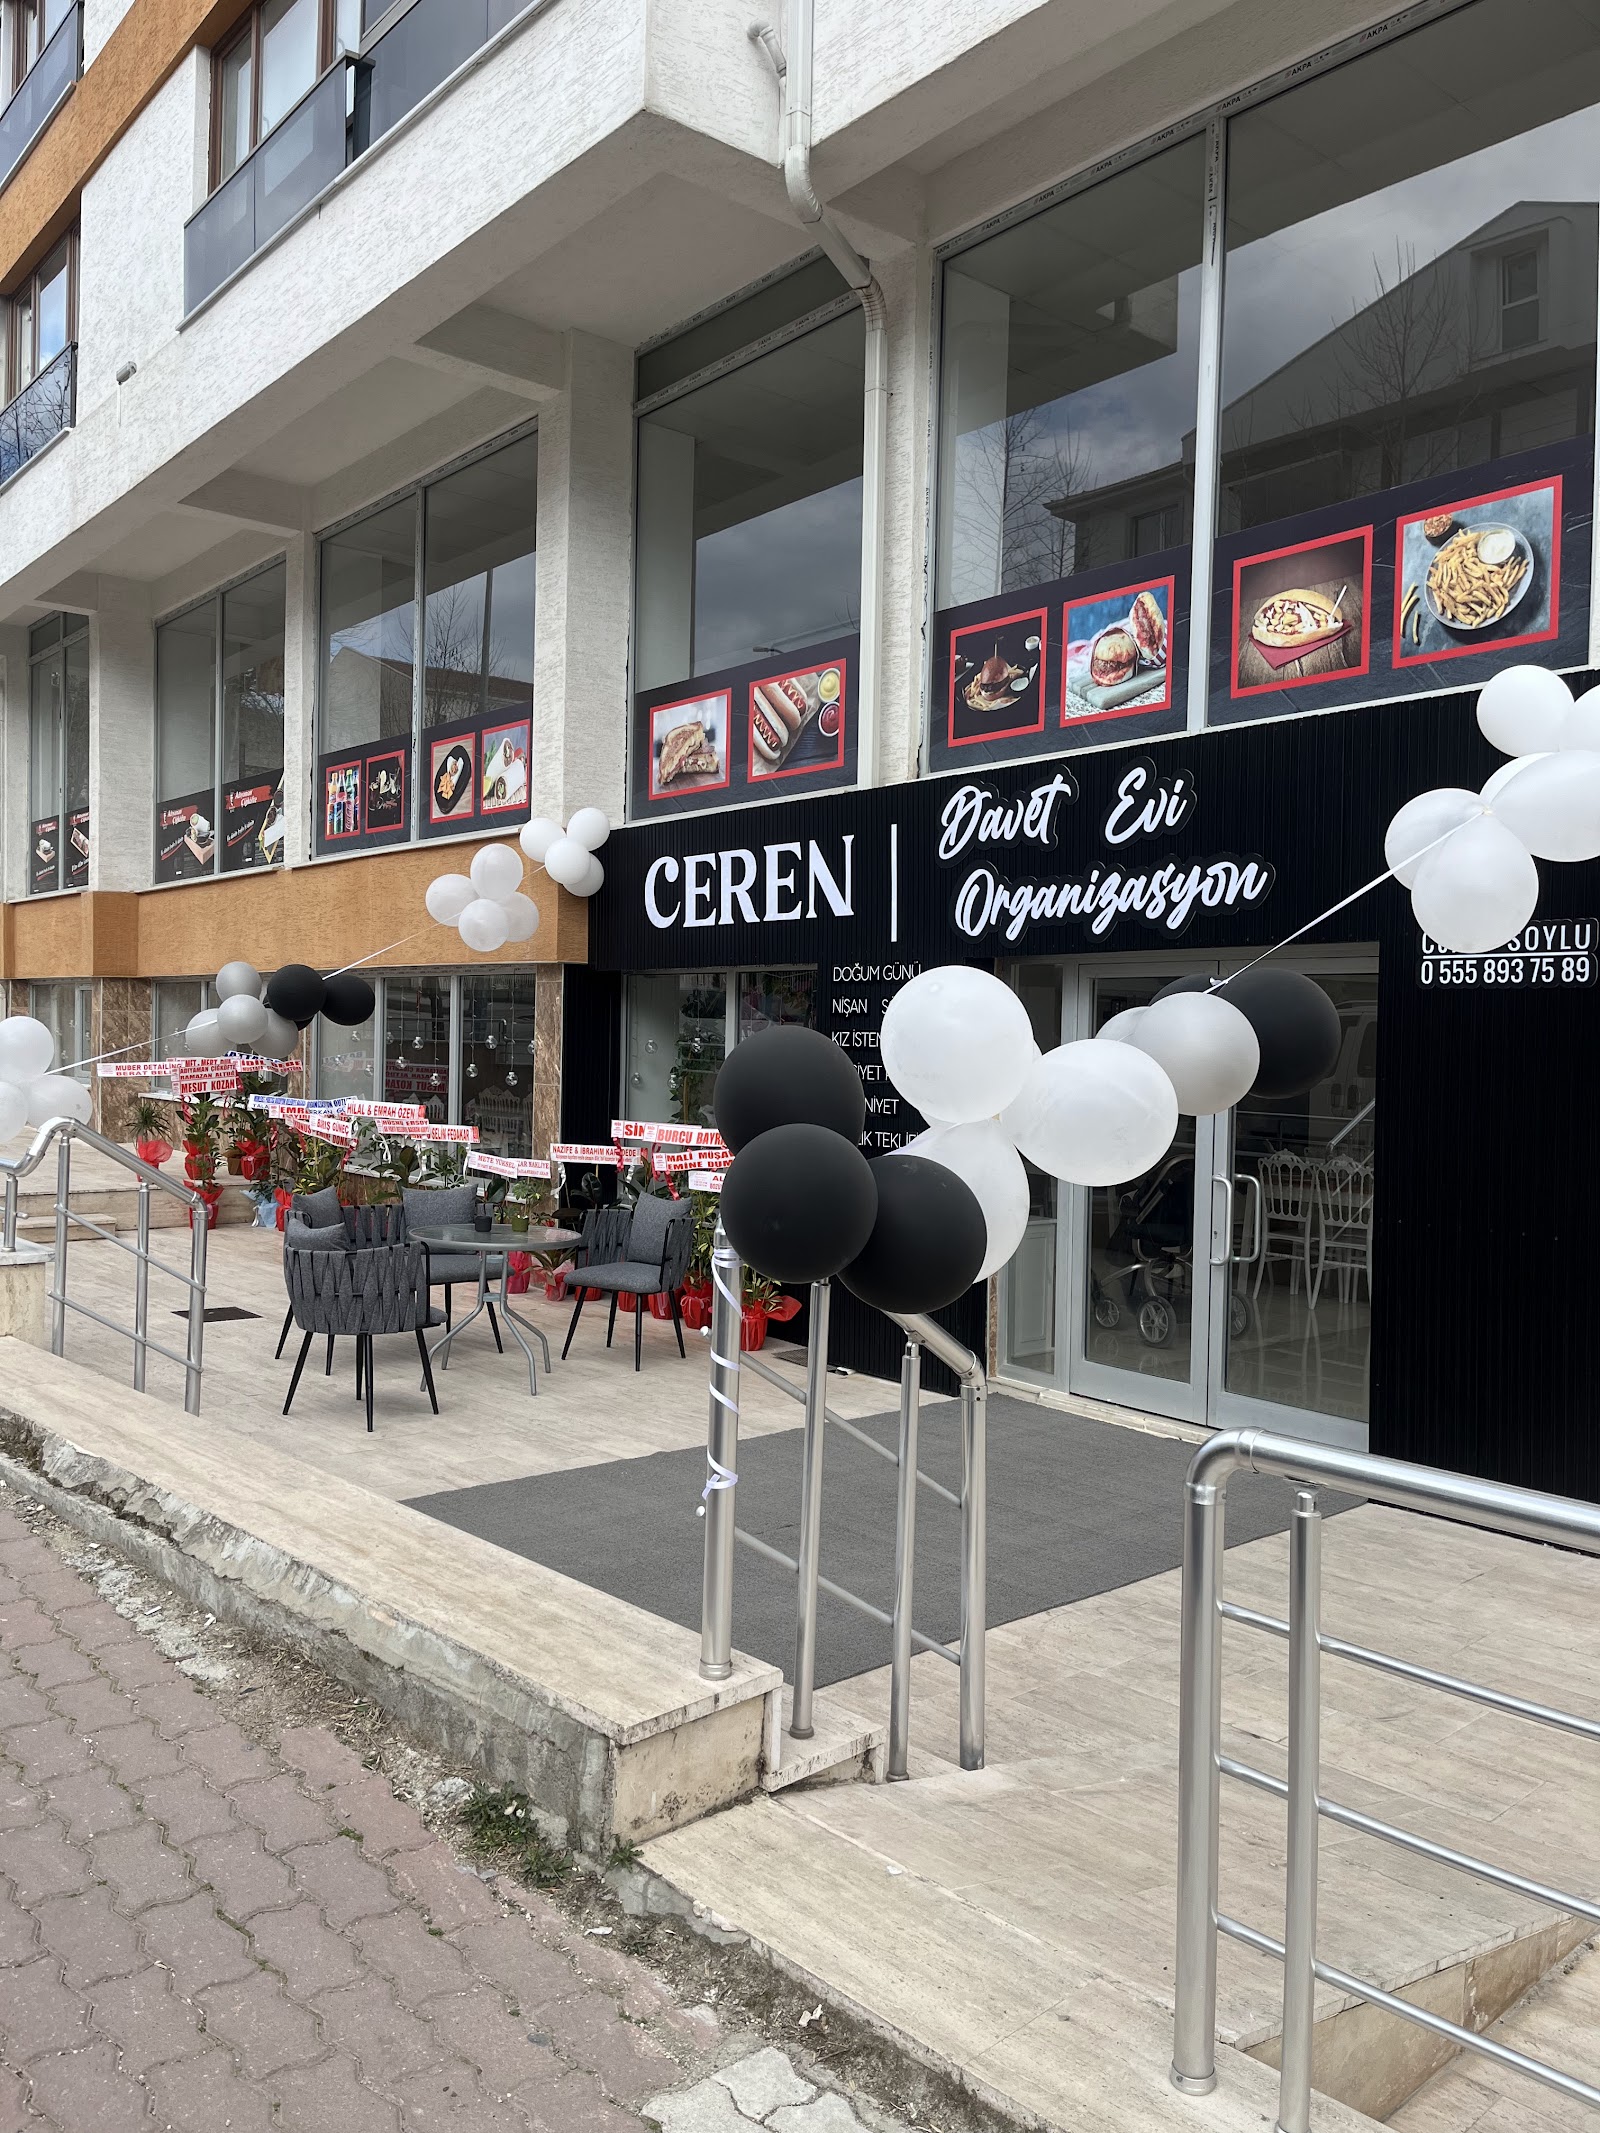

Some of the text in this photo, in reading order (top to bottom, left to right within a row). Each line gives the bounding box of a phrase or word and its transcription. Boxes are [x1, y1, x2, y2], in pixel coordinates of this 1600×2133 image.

[938, 766, 1188, 860] Davet Evi
[644, 834, 856, 930] CEREN
[954, 860, 1268, 941] Organizasyon
[833, 961, 922, 982] DOĞUM GÜNÜ
[1421, 957, 1590, 985] 0 555 893 75 89
[832, 996, 868, 1018] NİŞAN
[831, 1031, 850, 1047] KIZ
[115, 1064, 140, 1072] MUBER
[180, 1066, 209, 1074] ADIYAMAN
[854, 1062, 883, 1081] İYET
[181, 1079, 235, 1094] MESUT KOZAN
[347, 1101, 365, 1115] HİLAL
[374, 1106, 396, 1118] EMRAH
[398, 1105, 415, 1119] ÖZEN
[657, 1129, 693, 1144] BURCU
[552, 1145, 573, 1154] NAZİFE
[580, 1146, 605, 1156] İBRAHİM
[666, 1150, 694, 1162] MALİ
[667, 1159, 734, 1171] EMİNE DUM
